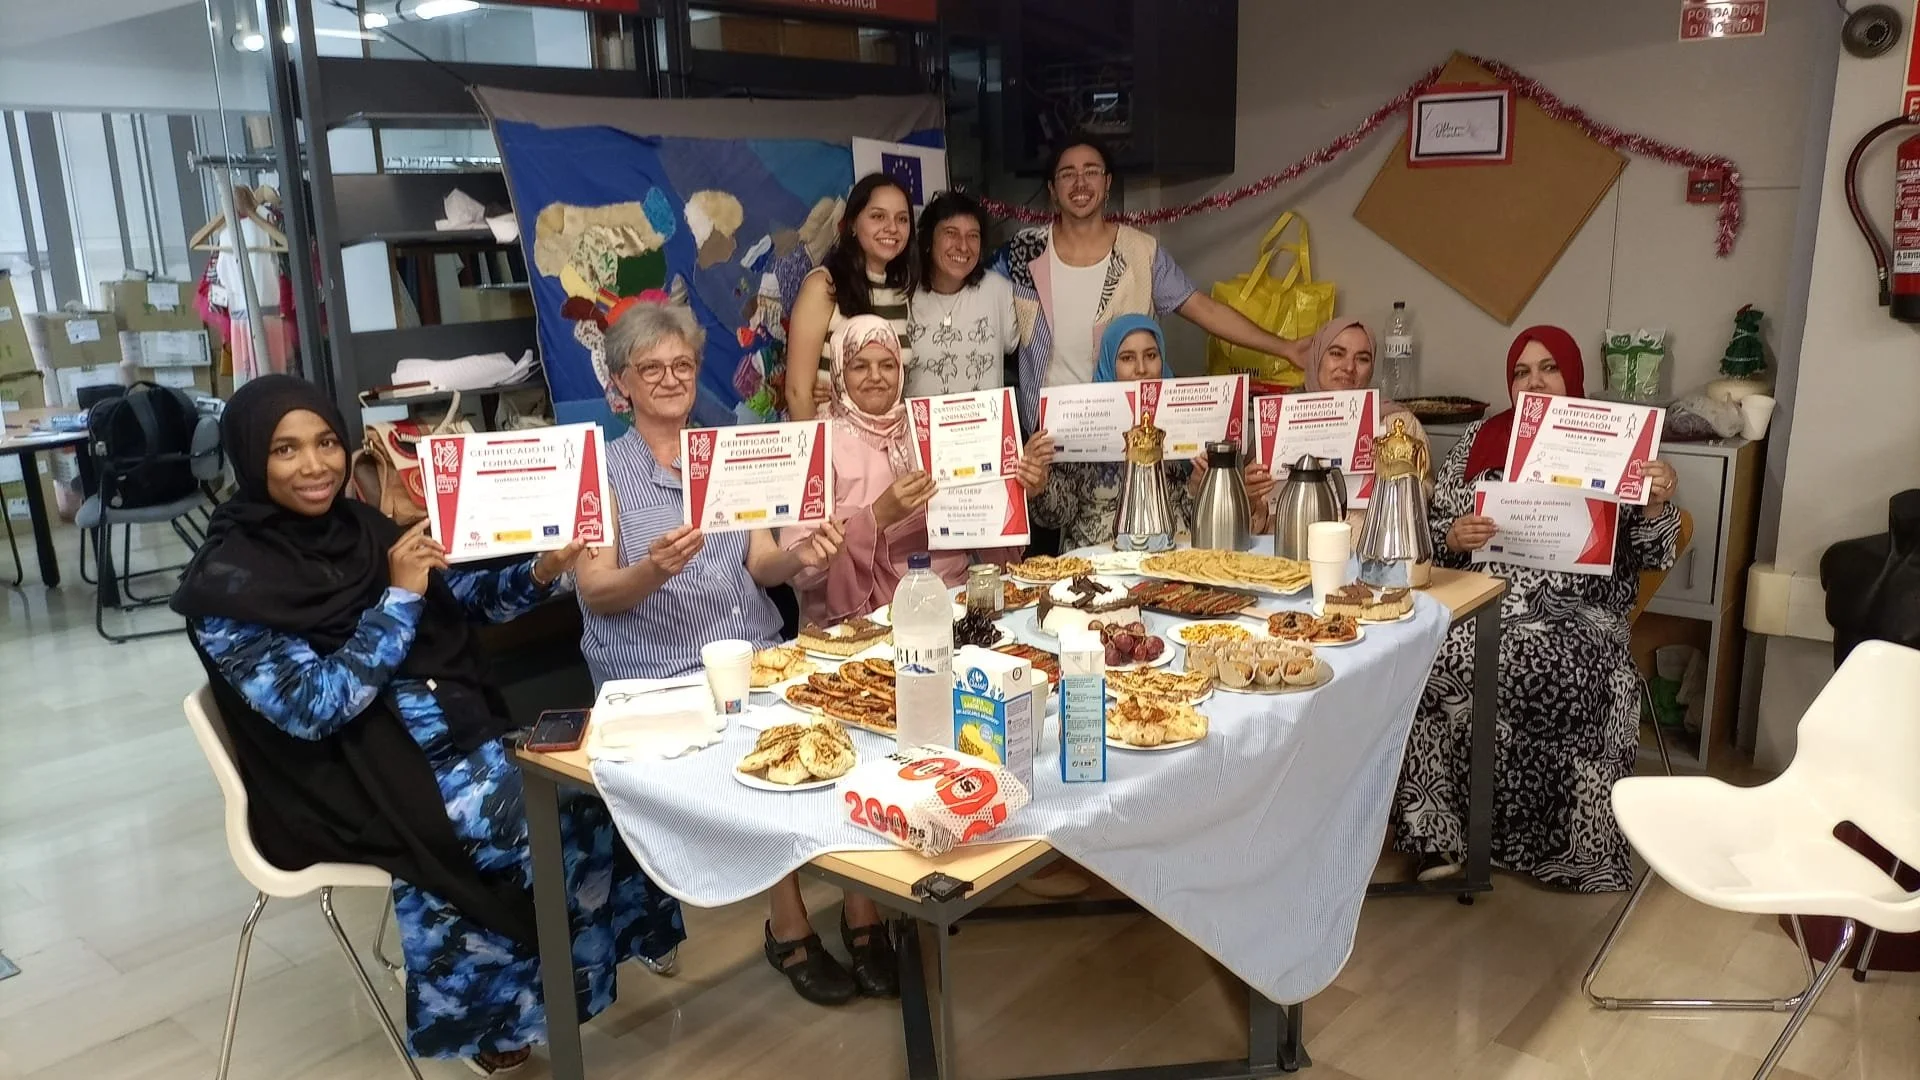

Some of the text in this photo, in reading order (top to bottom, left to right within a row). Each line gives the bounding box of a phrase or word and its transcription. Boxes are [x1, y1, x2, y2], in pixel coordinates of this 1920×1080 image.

[1687, 4, 1760, 21] POLSADOR
[1164, 387, 1209, 396] CERTIFICADO
[1285, 401, 1345, 412] CERTIFICADO DE
[1293, 409, 1337, 419] FORMACIÓN
[1551, 407, 1623, 423] CERTIFICADO DE
[1559, 418, 1611, 430] FORMACIÓN
[720, 435, 793, 449] CERTIFICADO DE
[730, 445, 783, 457] FORMACIÓN
[1500, 498, 1532, 506] Certificado
[845, 790, 908, 841] 200
